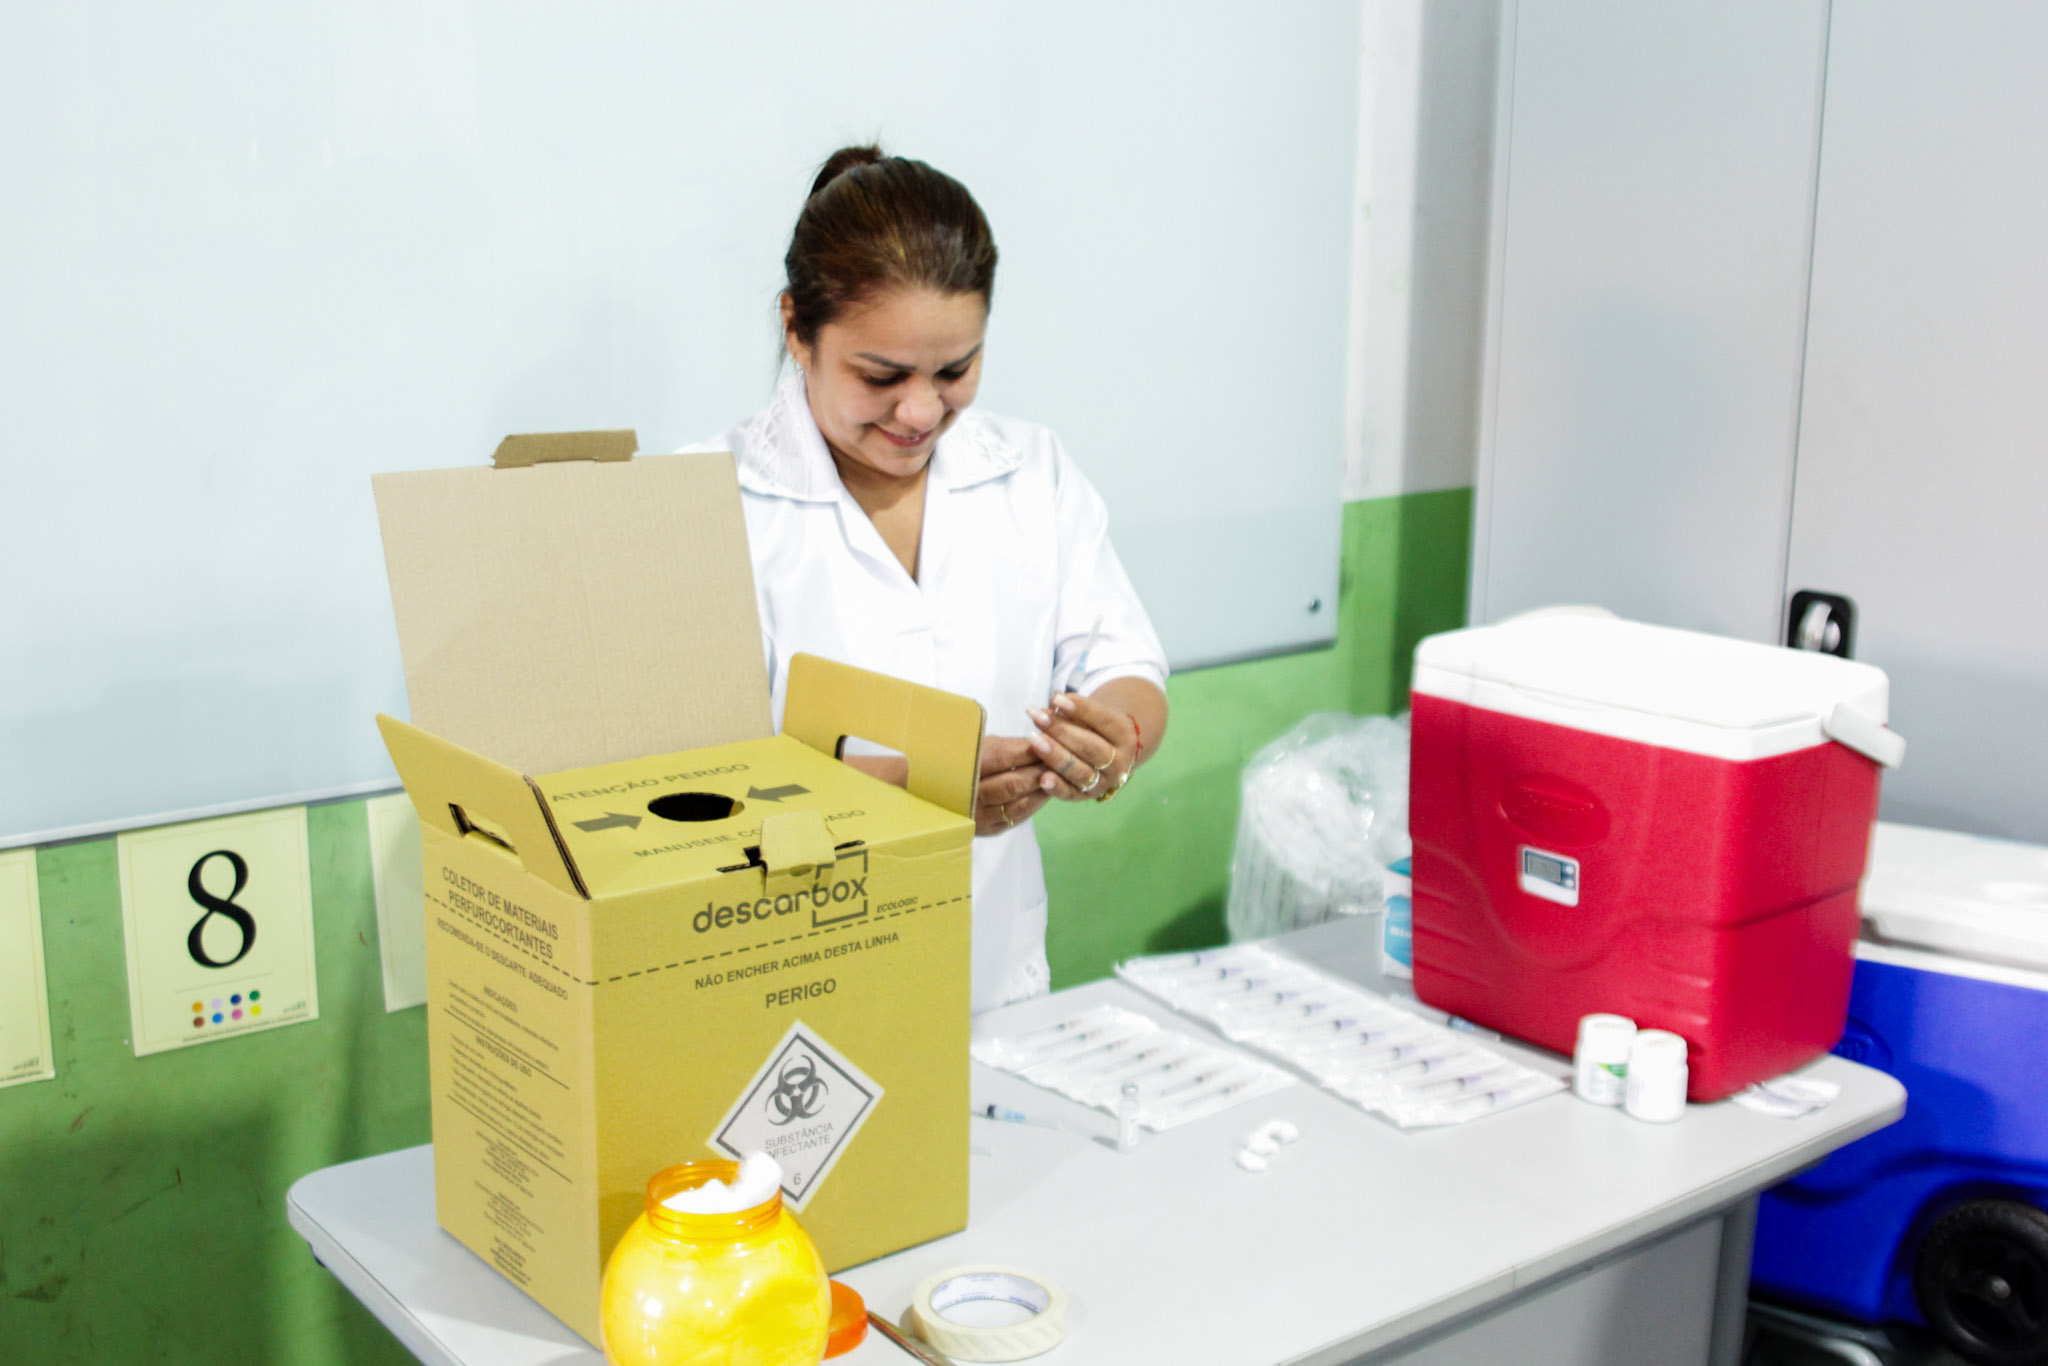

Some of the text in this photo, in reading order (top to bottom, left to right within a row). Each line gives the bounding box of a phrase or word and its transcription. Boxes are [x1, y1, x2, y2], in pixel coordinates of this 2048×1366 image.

[551, 763, 751, 803] ATENÇÃO PERIGO
[634, 832, 735, 858] MANUSEIE
[186, 849, 257, 970] 8
[442, 866, 559, 941] COLETOR DE MATERIAIS
[448, 890, 554, 960] PERFUROCORTANTES
[692, 876, 919, 934] descarbox ECOLOGIC
[437, 917, 485, 955] RECOMENDA-SE
[491, 950, 527, 978] DESCARTE
[529, 970, 569, 1001] ADEQUADO
[694, 931, 900, 991] NÃO ENCHER ACIMA DESTA LINHA
[765, 978, 837, 1009] PERIGO
[766, 1123, 833, 1149] SUBSTÂNCIA
[793, 1173, 802, 1185] 6
